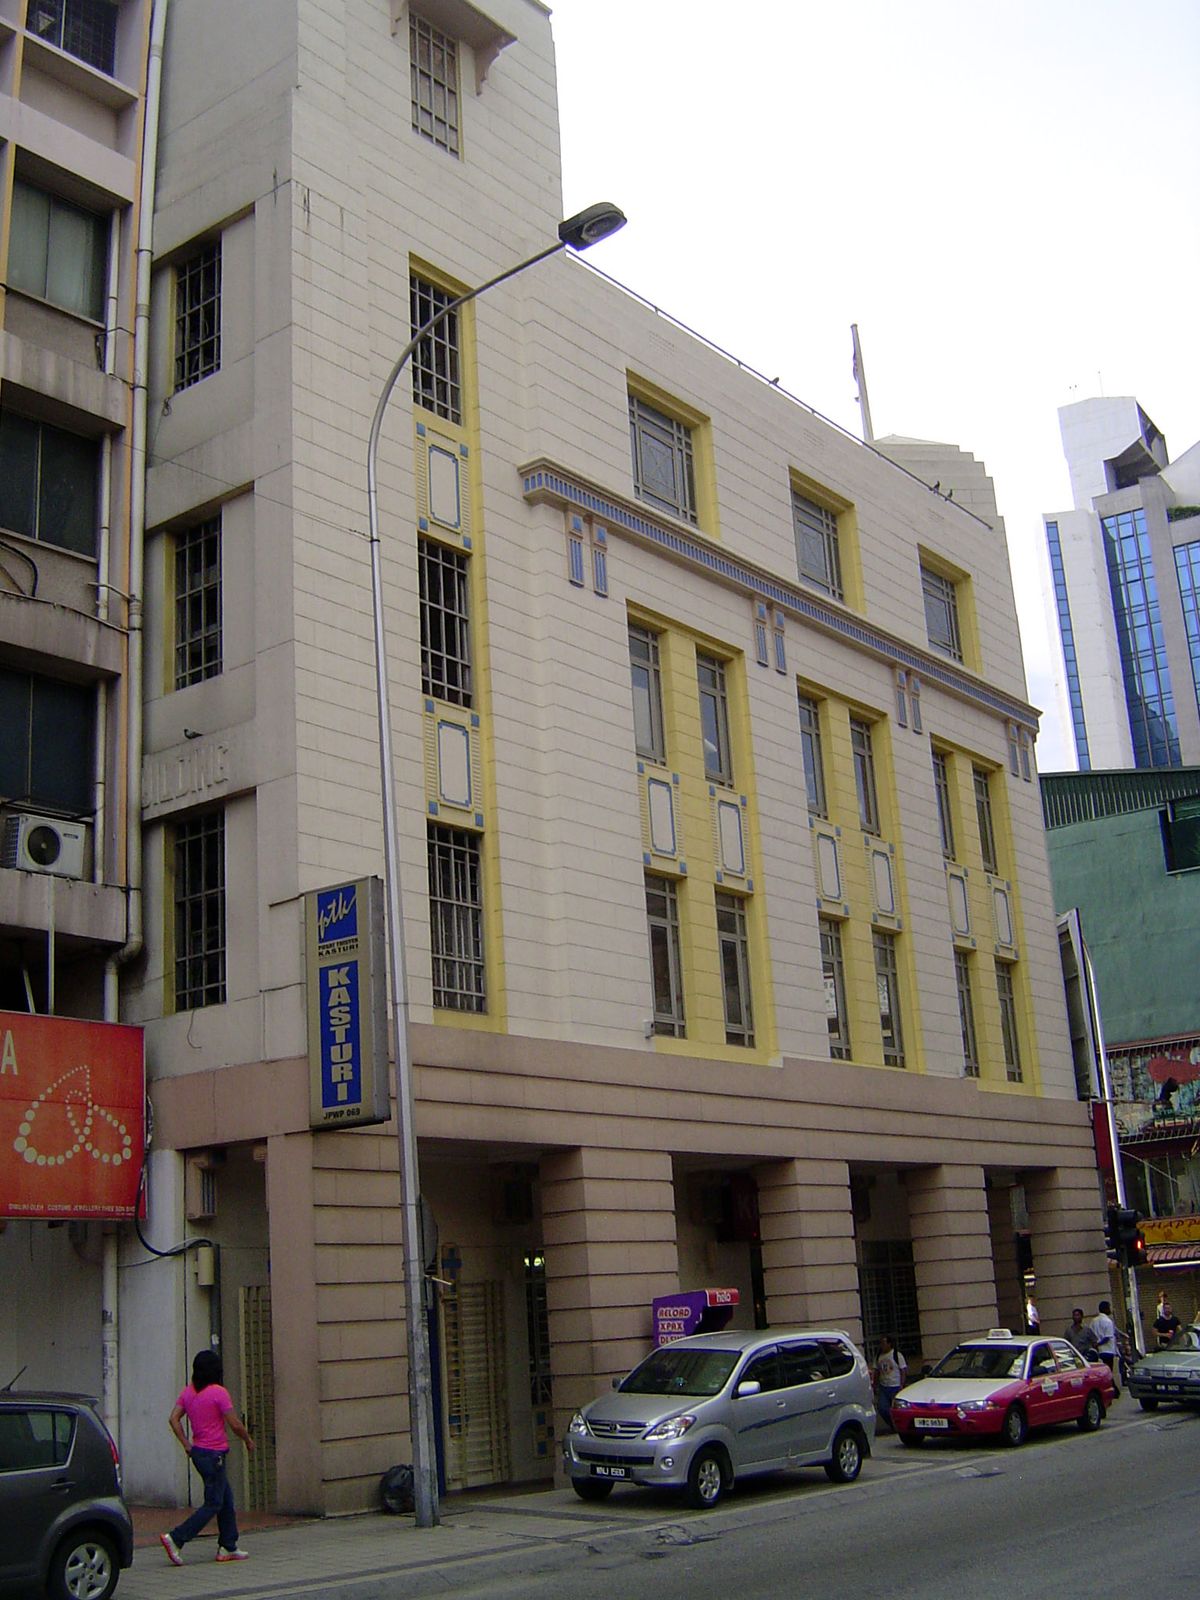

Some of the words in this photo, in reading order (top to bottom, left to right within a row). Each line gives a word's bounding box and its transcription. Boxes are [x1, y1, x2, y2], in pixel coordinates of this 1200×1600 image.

[318, 943, 359, 957] KASTURI
[328, 967, 353, 1101] KASTURI
[660, 1308, 690, 1318] RELOAD
[660, 1322, 683, 1331] XPAX
